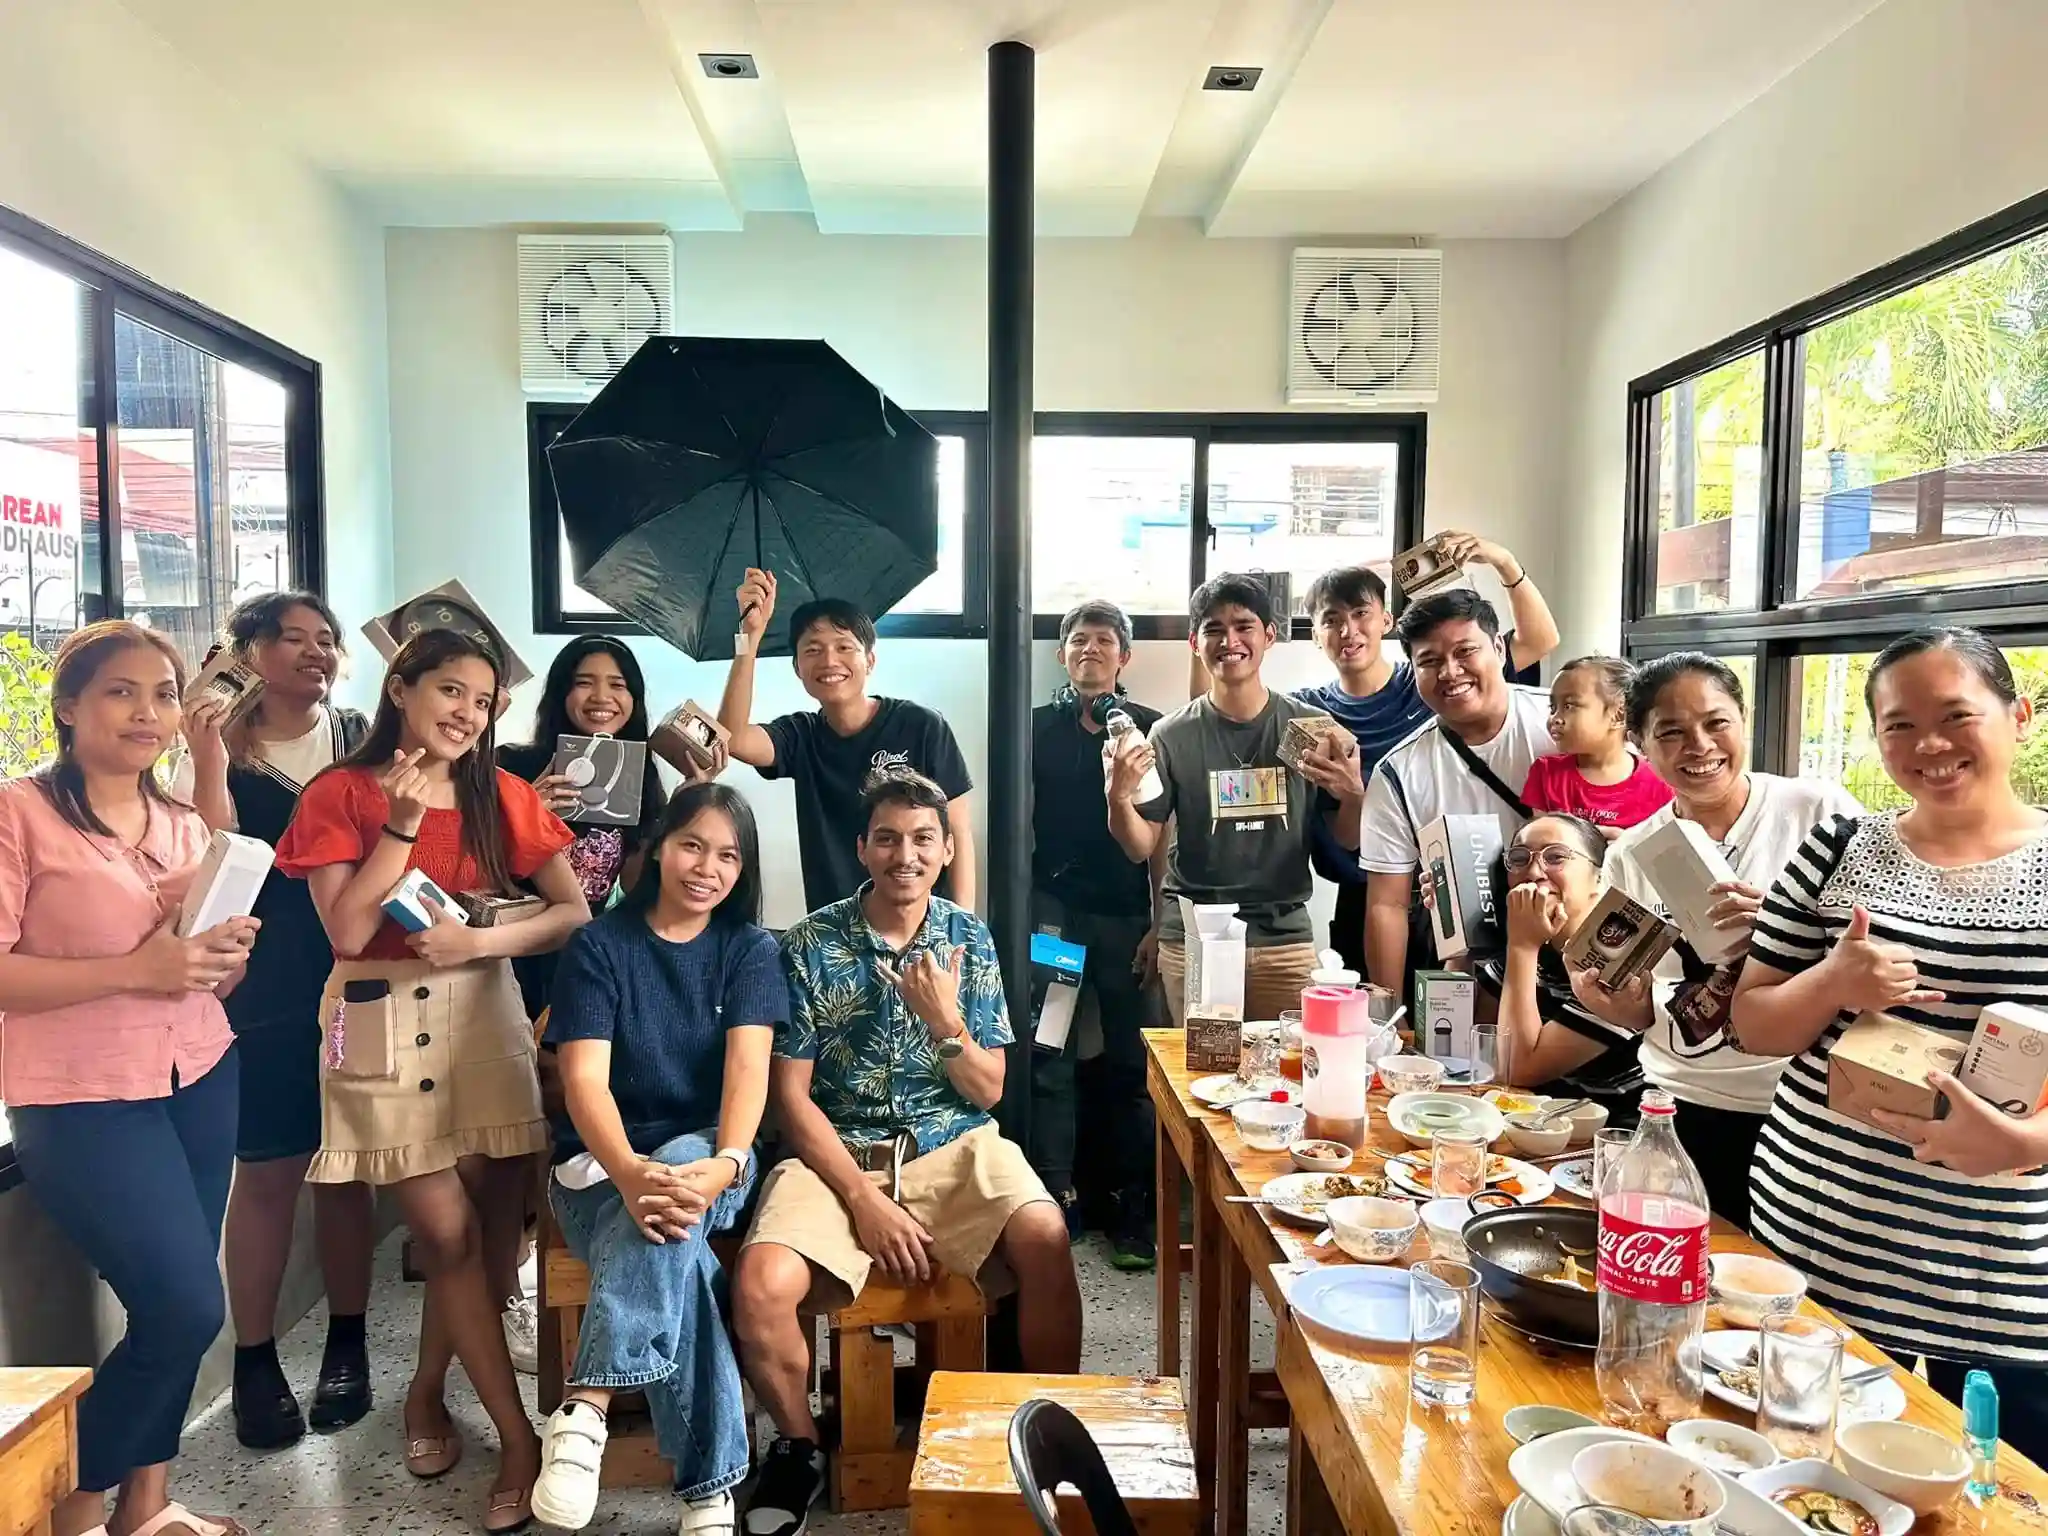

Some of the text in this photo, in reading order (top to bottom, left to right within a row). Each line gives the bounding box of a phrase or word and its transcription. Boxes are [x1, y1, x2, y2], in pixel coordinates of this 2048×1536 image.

[0, 494, 62, 530] REAN
[0, 525, 74, 559] DHAUS
[436, 607, 453, 623] 10
[471, 629, 489, 645] 12
[1469, 833, 1498, 927] UNIBEST
[1627, 1274, 1659, 1288] TASTE
